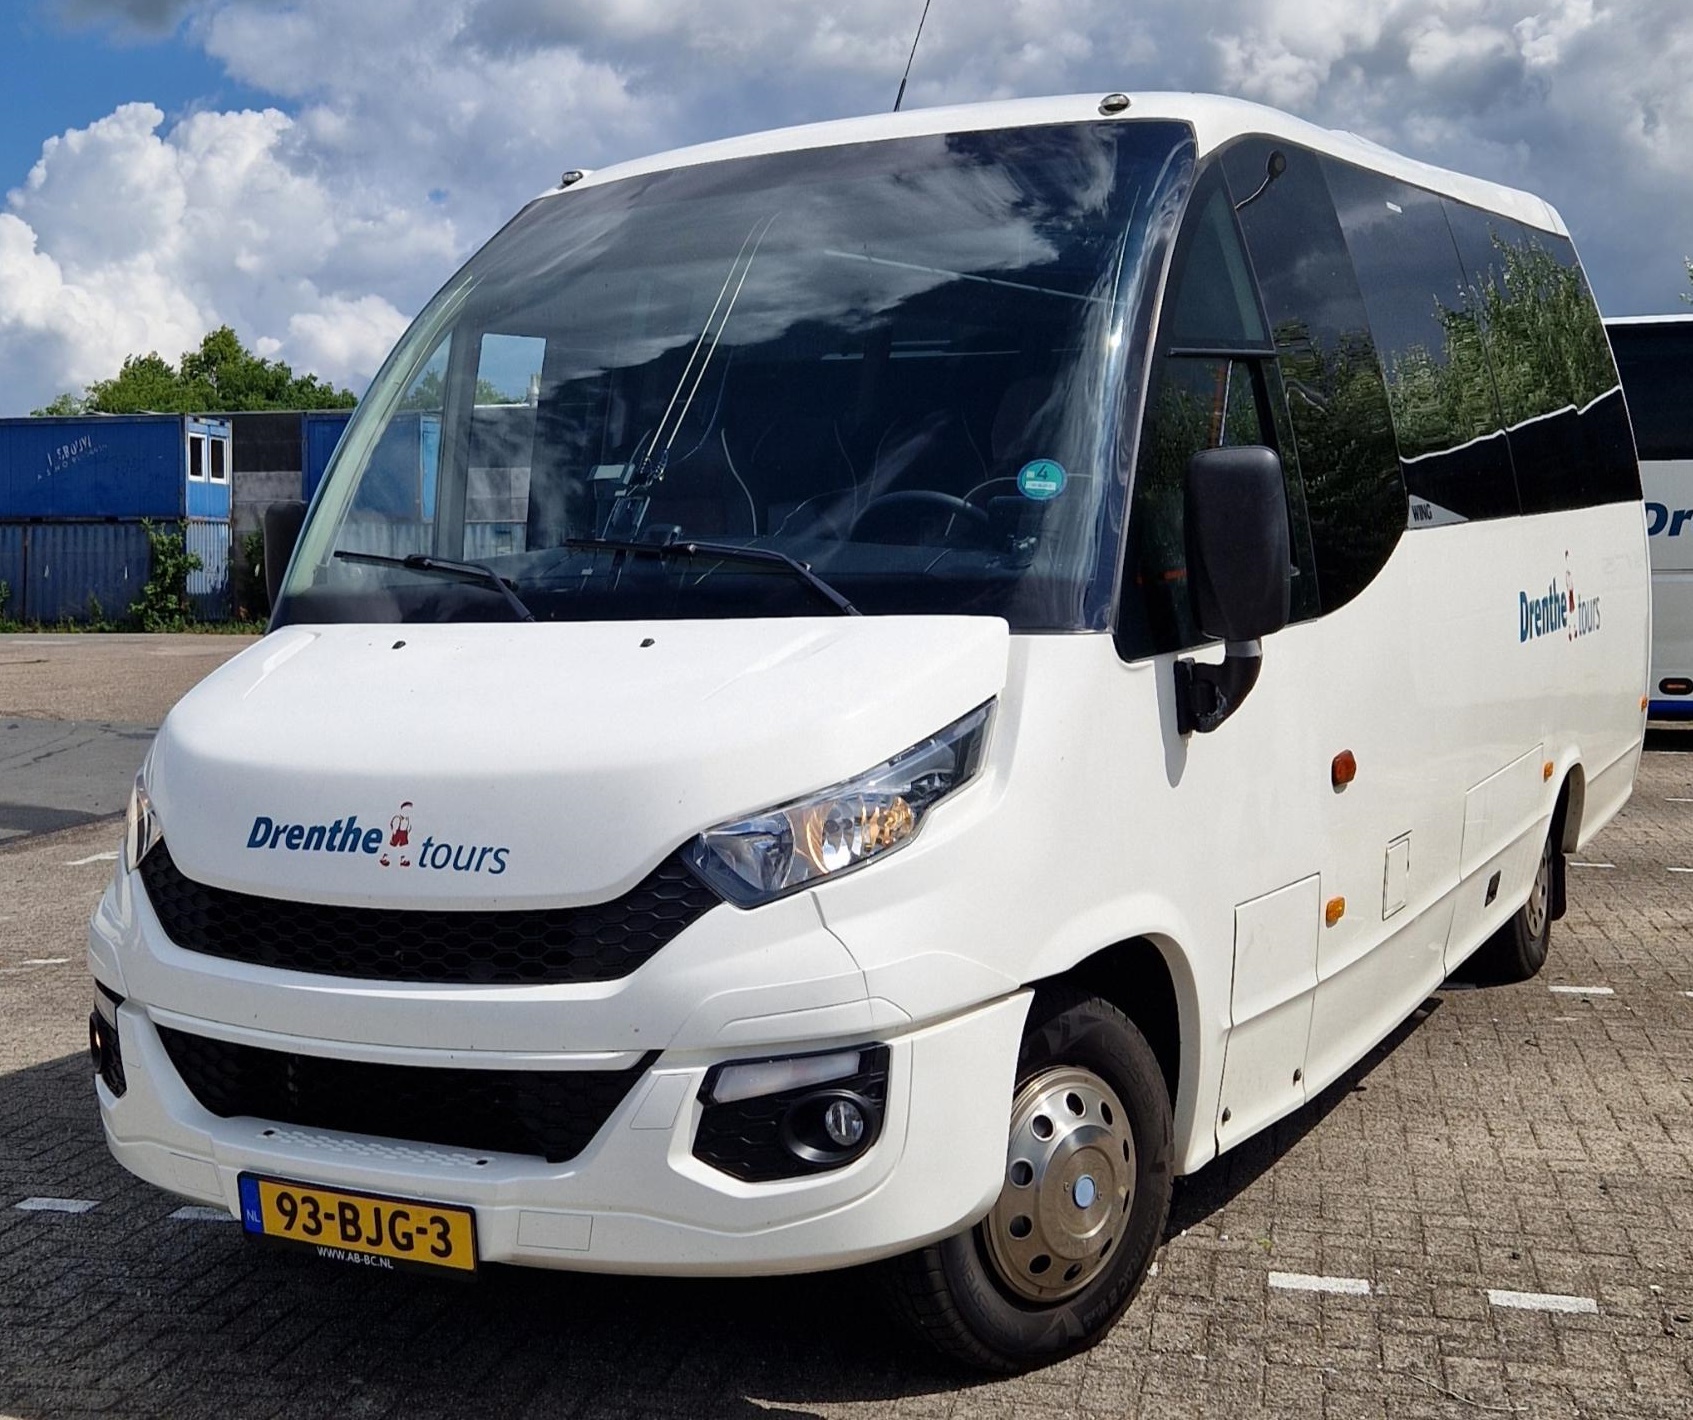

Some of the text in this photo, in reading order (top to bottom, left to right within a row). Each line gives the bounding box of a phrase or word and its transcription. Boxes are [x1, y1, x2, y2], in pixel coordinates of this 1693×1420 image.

[1036, 464, 1048, 480] 4
[1411, 503, 1432, 522] WING
[1519, 577, 1600, 643] Drenthe tours
[246, 815, 510, 875] Drenthe tours
[246, 1211, 262, 1224] NL
[275, 1191, 453, 1259] 93-BJG-3
[316, 1245, 394, 1270] WWW.AB-BC.NL
